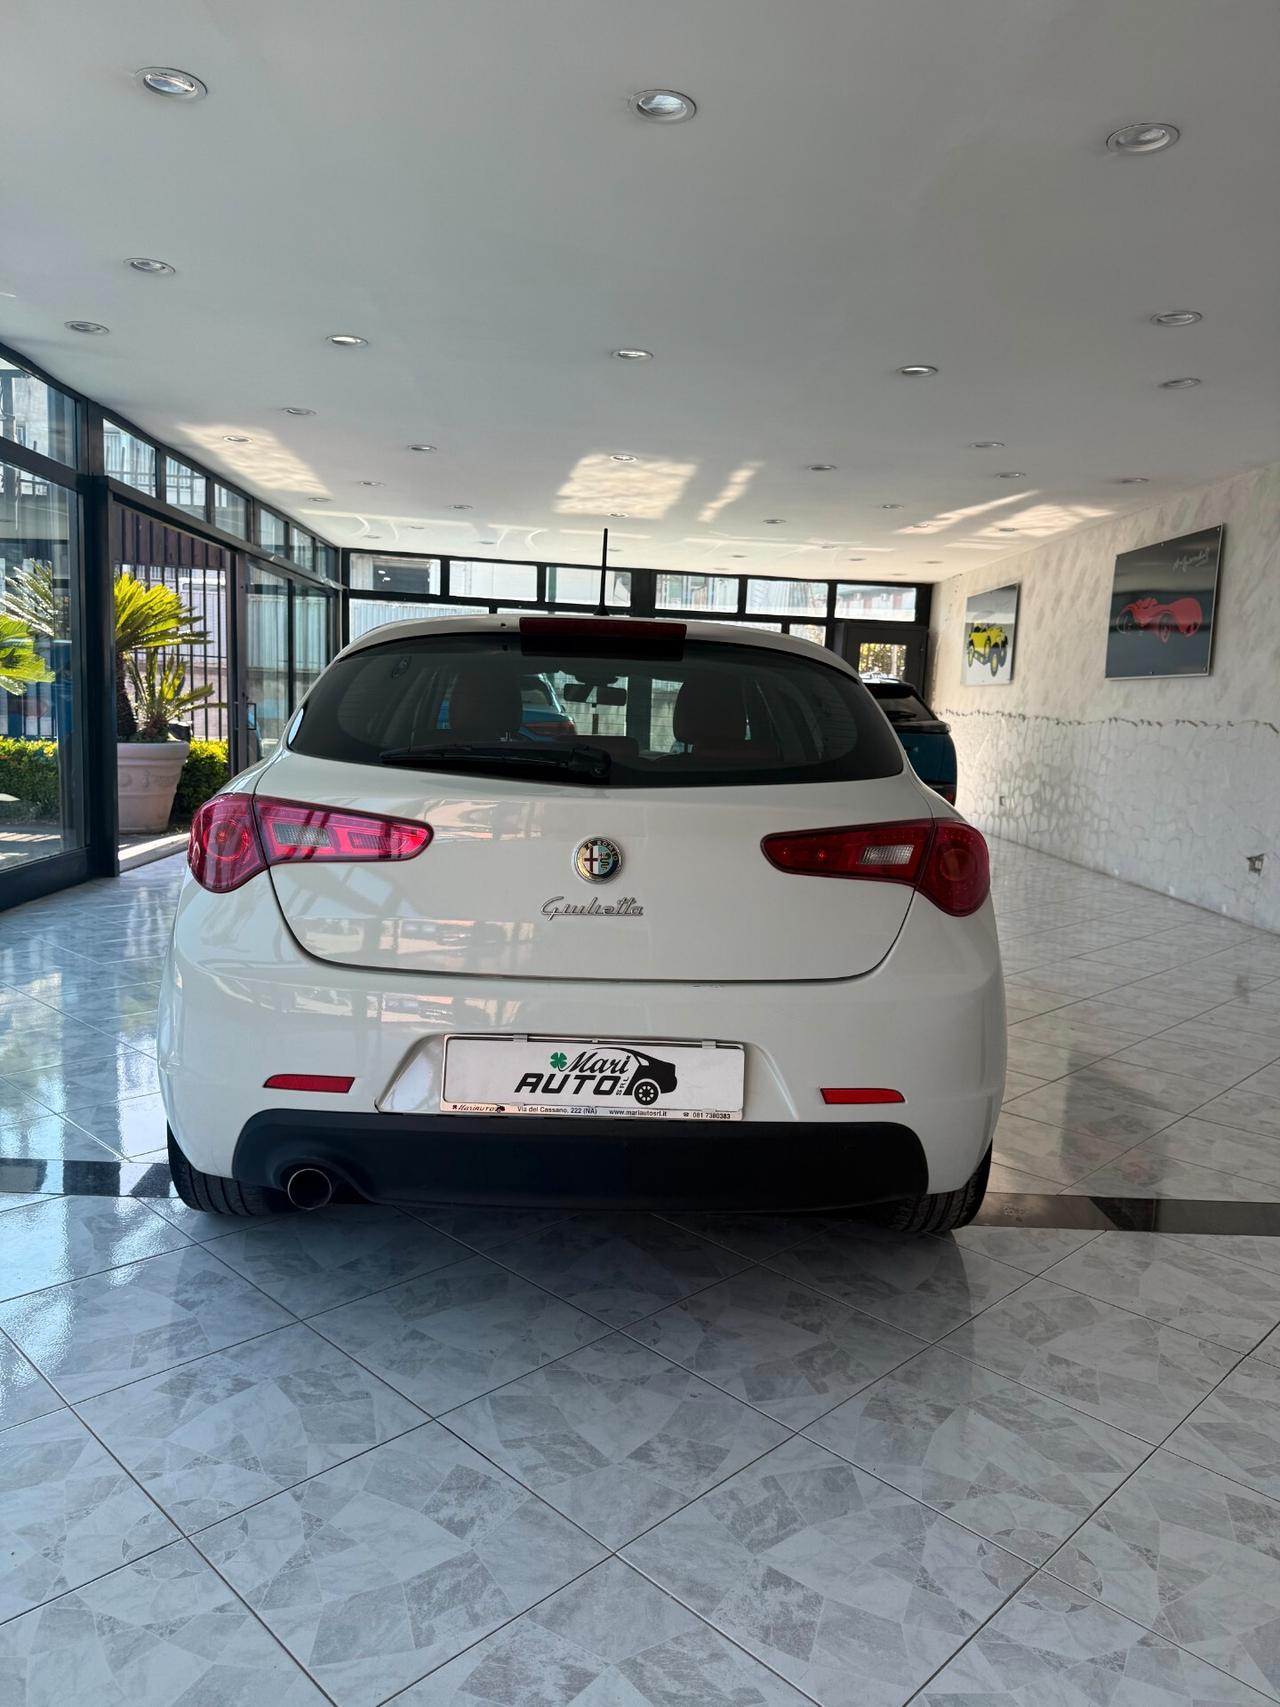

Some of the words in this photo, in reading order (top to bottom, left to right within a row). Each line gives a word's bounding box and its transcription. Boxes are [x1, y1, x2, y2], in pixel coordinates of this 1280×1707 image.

[540, 895, 645, 921] Giulietta
[560, 1051, 631, 1075] Mari
[514, 1073, 622, 1096] AUTO
[615, 1076, 630, 1096] SRL
[583, 1107, 598, 1115] (NA)
[608, 1109, 667, 1117] www.mariautosrl.it
